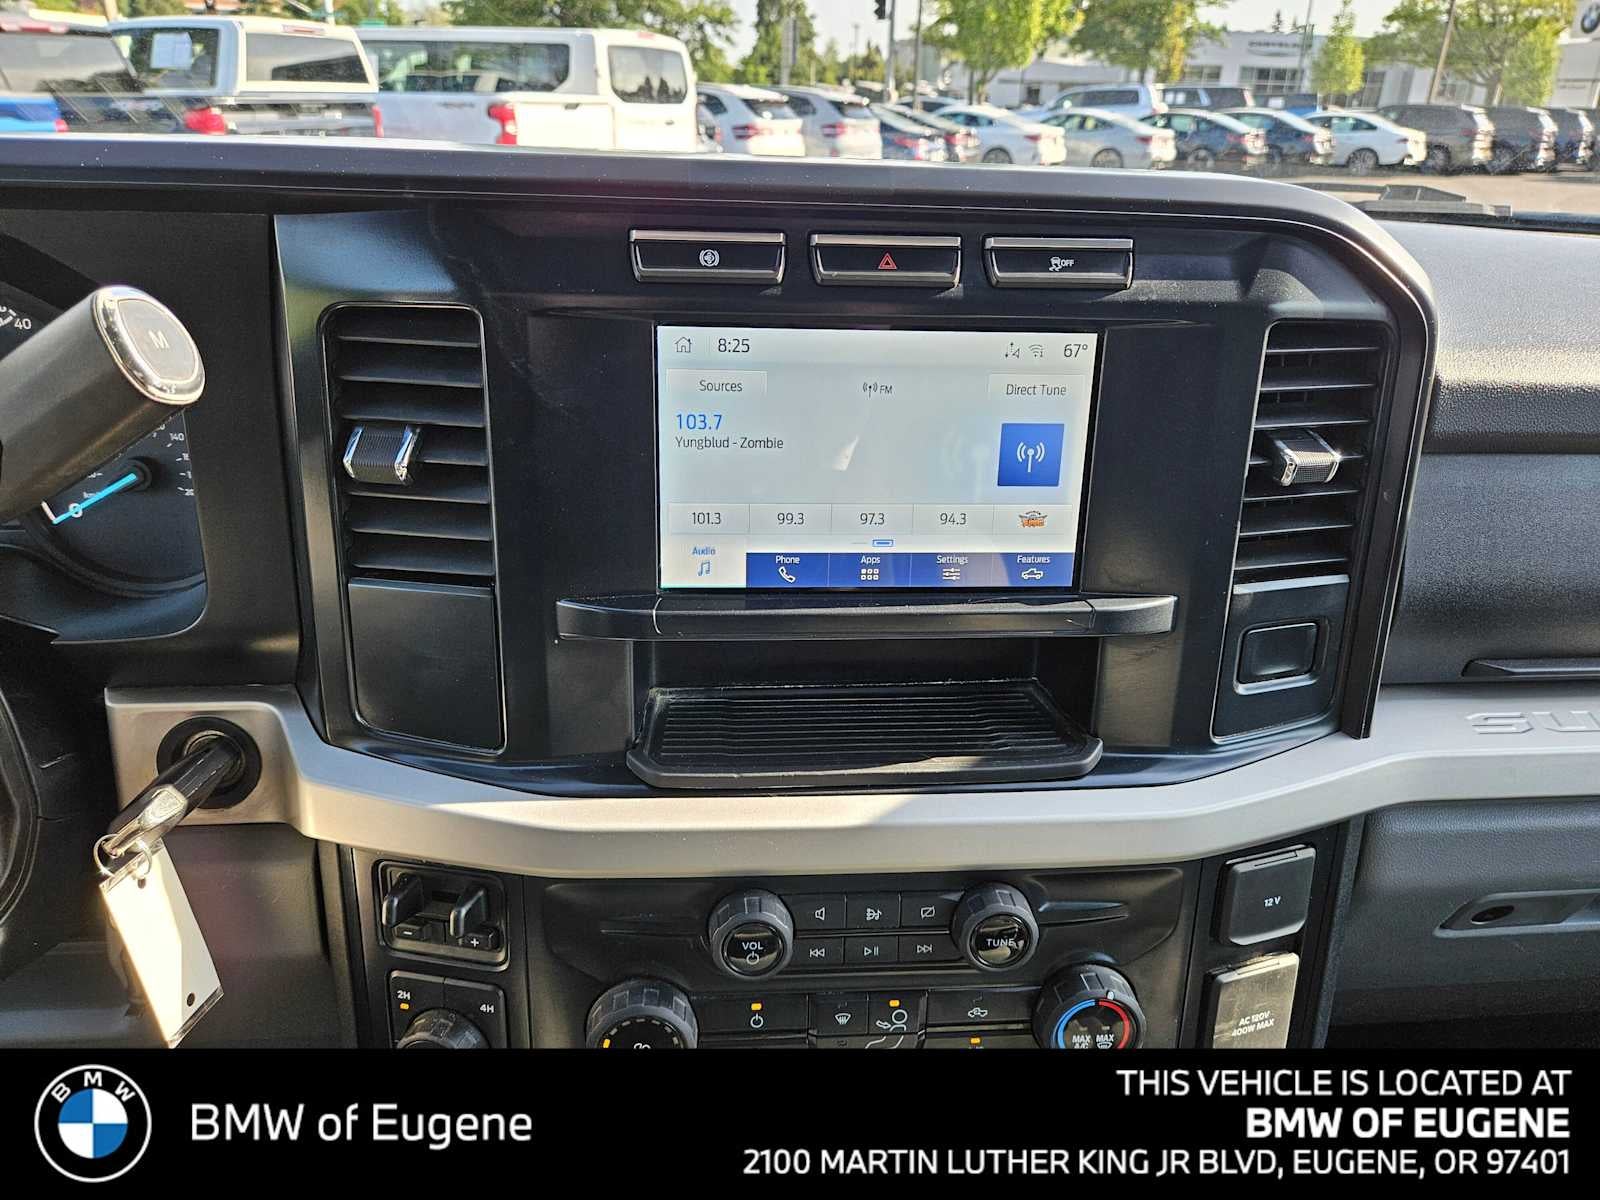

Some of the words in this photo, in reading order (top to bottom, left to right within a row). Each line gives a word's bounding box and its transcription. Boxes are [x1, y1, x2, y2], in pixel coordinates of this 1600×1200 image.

[1060, 259, 1075, 267] OFF
[14, 318, 32, 330] 40
[148, 329, 170, 349] M
[717, 338, 750, 354] 8:25
[1063, 343, 1089, 358] 67°
[699, 380, 743, 393] Sources
[879, 385, 893, 395] FM
[1005, 383, 1036, 396] Direct
[1040, 384, 1067, 396] Tune
[676, 413, 723, 431] 103.7
[675, 436, 730, 450] Yungblud
[739, 437, 784, 449] Zombie
[691, 511, 722, 525] 101.3
[777, 512, 805, 526] 99.3
[859, 512, 885, 526] 97.3
[939, 512, 967, 526] 94.3
[692, 546, 716, 556] Audio
[775, 555, 800, 565] Phone
[860, 555, 881, 566] Apps
[936, 554, 969, 566] Settings
[1016, 555, 1051, 565] Features
[1264, 898, 1273, 907] 12
[1274, 896, 1281, 905] V
[741, 941, 764, 950] VOL
[986, 938, 1017, 948] TUNE
[397, 990, 411, 1000] 2H
[480, 1004, 495, 1013] 4H
[1238, 1016, 1250, 1026] AC
[1251, 1010, 1271, 1023] 120V
[1231, 1024, 1256, 1037] 400W
[1256, 1018, 1275, 1030] MAX
[1072, 1034, 1091, 1043] MAX
[1095, 1034, 1115, 1043] MAX
